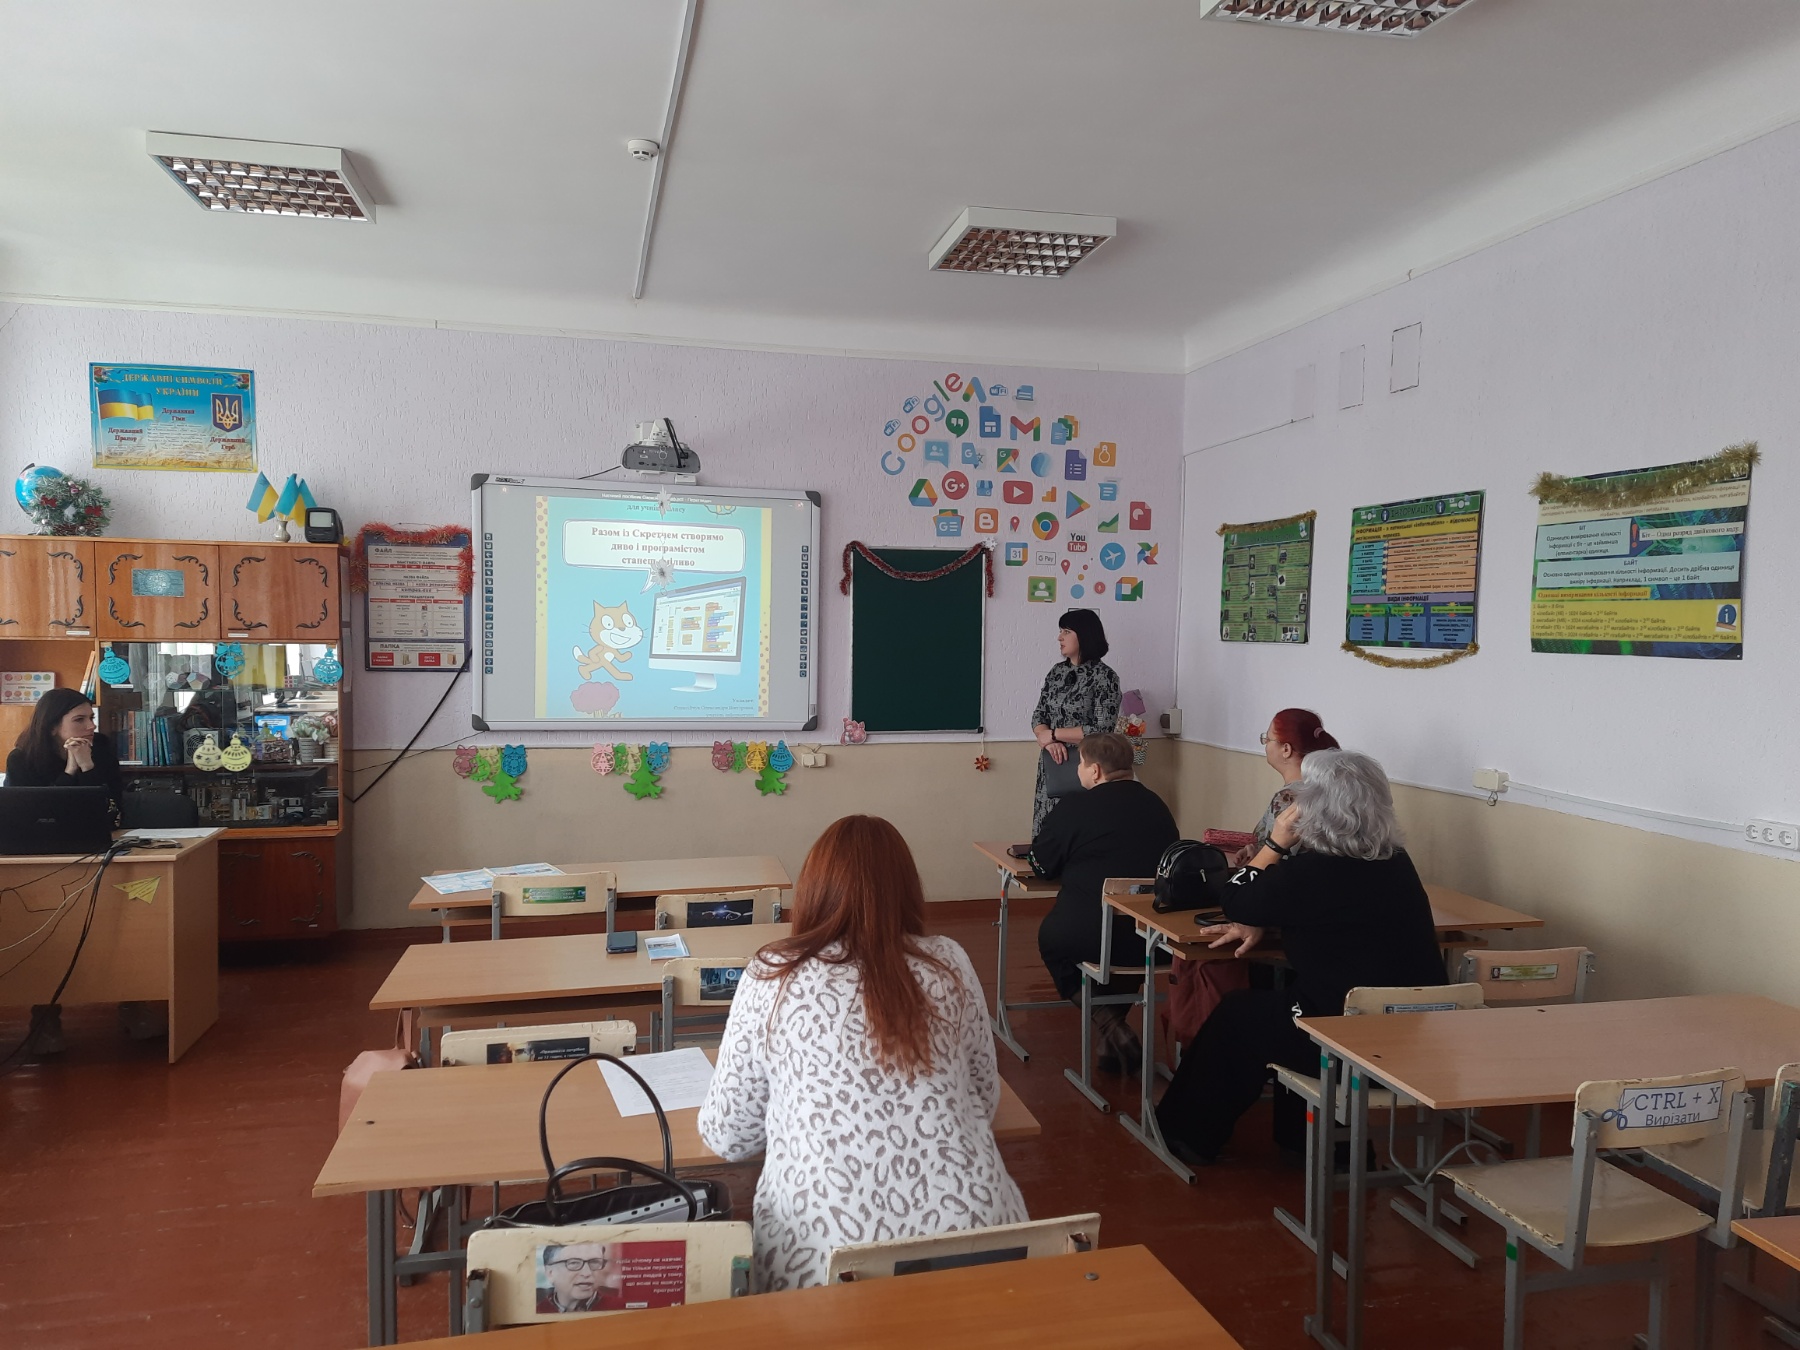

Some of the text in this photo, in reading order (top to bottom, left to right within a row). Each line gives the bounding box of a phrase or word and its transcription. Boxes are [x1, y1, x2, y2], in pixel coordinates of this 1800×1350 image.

[121, 373, 223, 386] ДЕРЖАВНІ СИМВОЛИ
[156, 387, 199, 397] УКРАЇНИ
[108, 427, 143, 435] Державний
[210, 436, 246, 444] Державний
[945, 478, 966, 492] G+
[592, 527, 724, 542] Разом із Скретчем створимо
[1070, 533, 1085, 541] You
[611, 543, 705, 555] диво і програмістом
[1069, 543, 1086, 551] Tube
[1012, 550, 1021, 559] 31
[1634, 1087, 1720, 1111] CTRL + X
[1646, 1112, 1700, 1128] Вирізати
